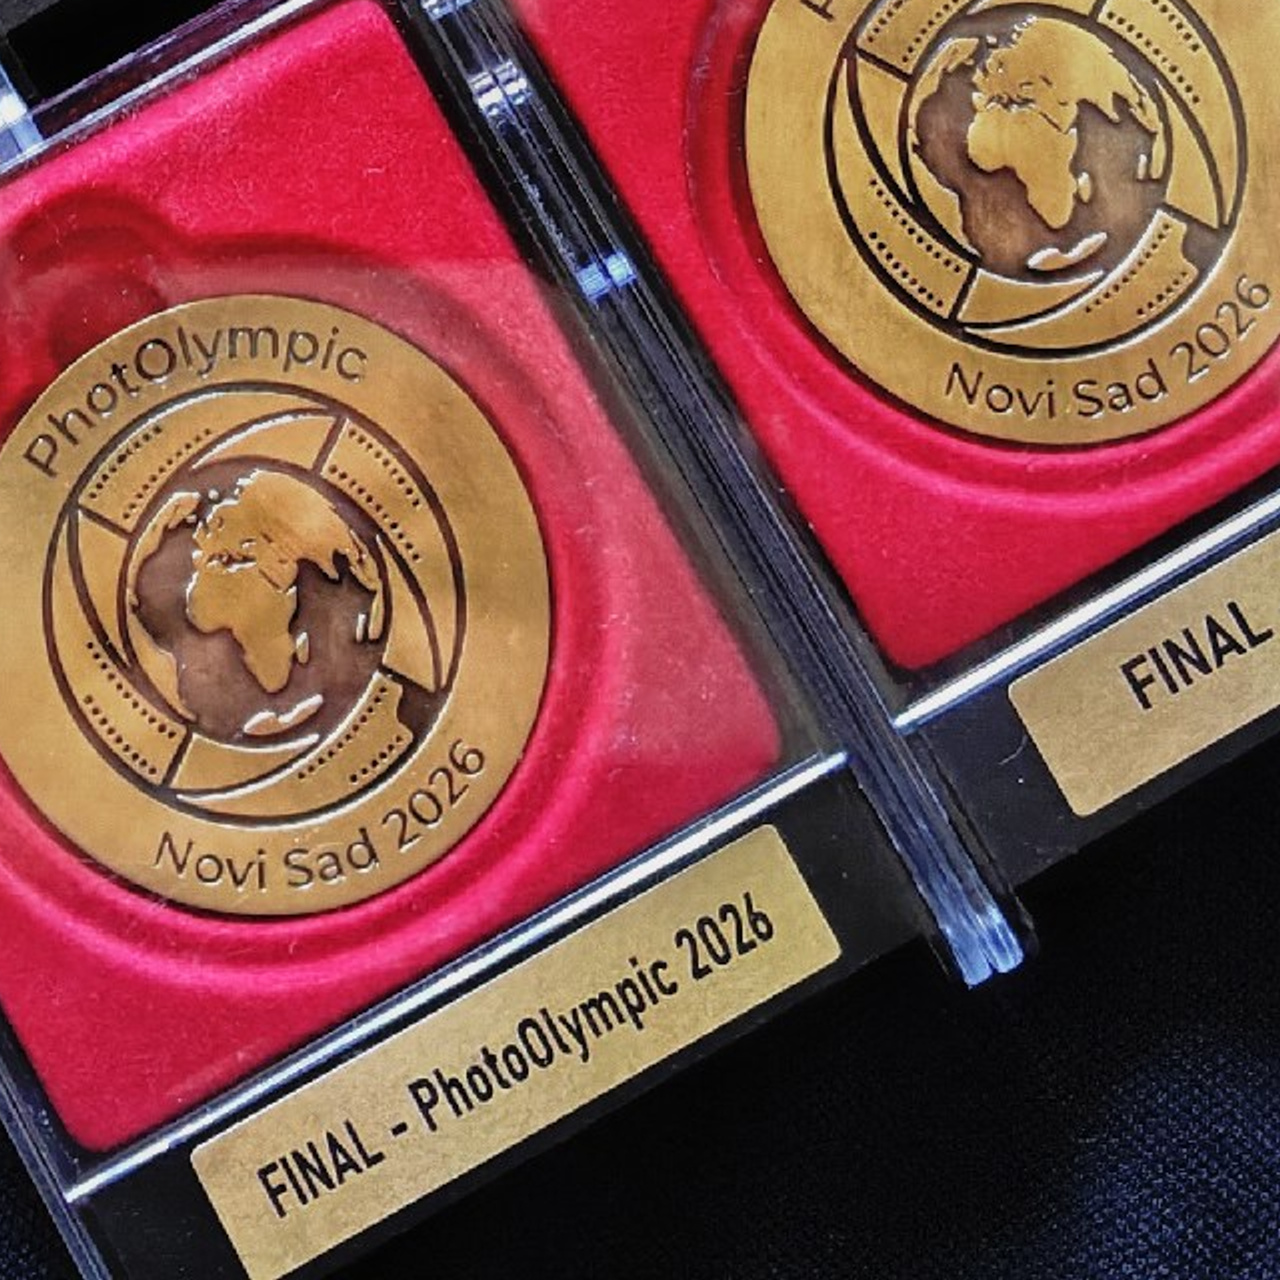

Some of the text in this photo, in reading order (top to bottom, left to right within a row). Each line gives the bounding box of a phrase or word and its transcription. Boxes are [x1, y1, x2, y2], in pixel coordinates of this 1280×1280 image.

[23, 324, 369, 479] PhotOlympic
[945, 274, 1272, 420] Novi Sad 2026
[1120, 601, 1275, 710] FINAL
[153, 739, 485, 891] Novi Sad 2026
[256, 891, 776, 1219] FINAL - PhotoOlympic 2026
